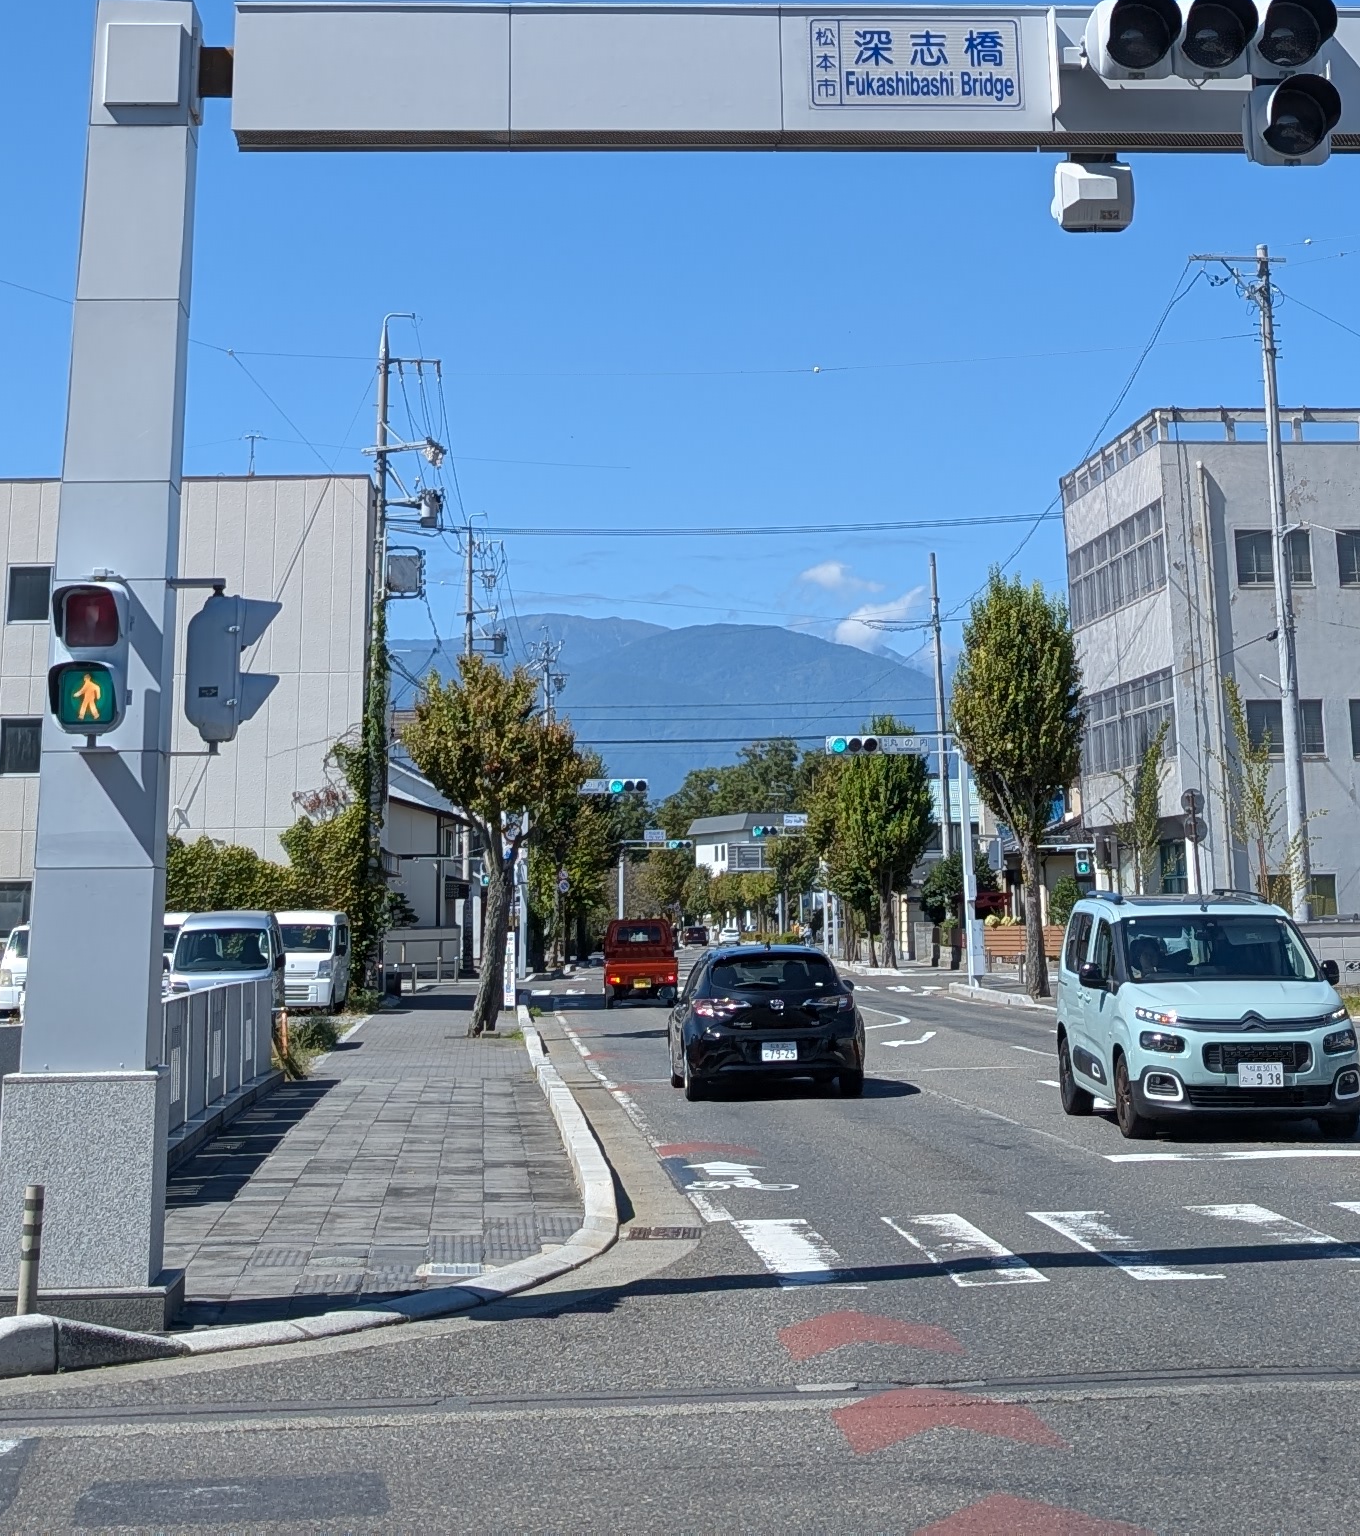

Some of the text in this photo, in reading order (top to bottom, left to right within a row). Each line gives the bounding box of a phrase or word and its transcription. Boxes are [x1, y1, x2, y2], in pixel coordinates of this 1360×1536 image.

[816, 27, 837, 98] 松本市
[854, 29, 1004, 67] 深志橋
[845, 70, 1015, 101] Fukashibashi Bridge
